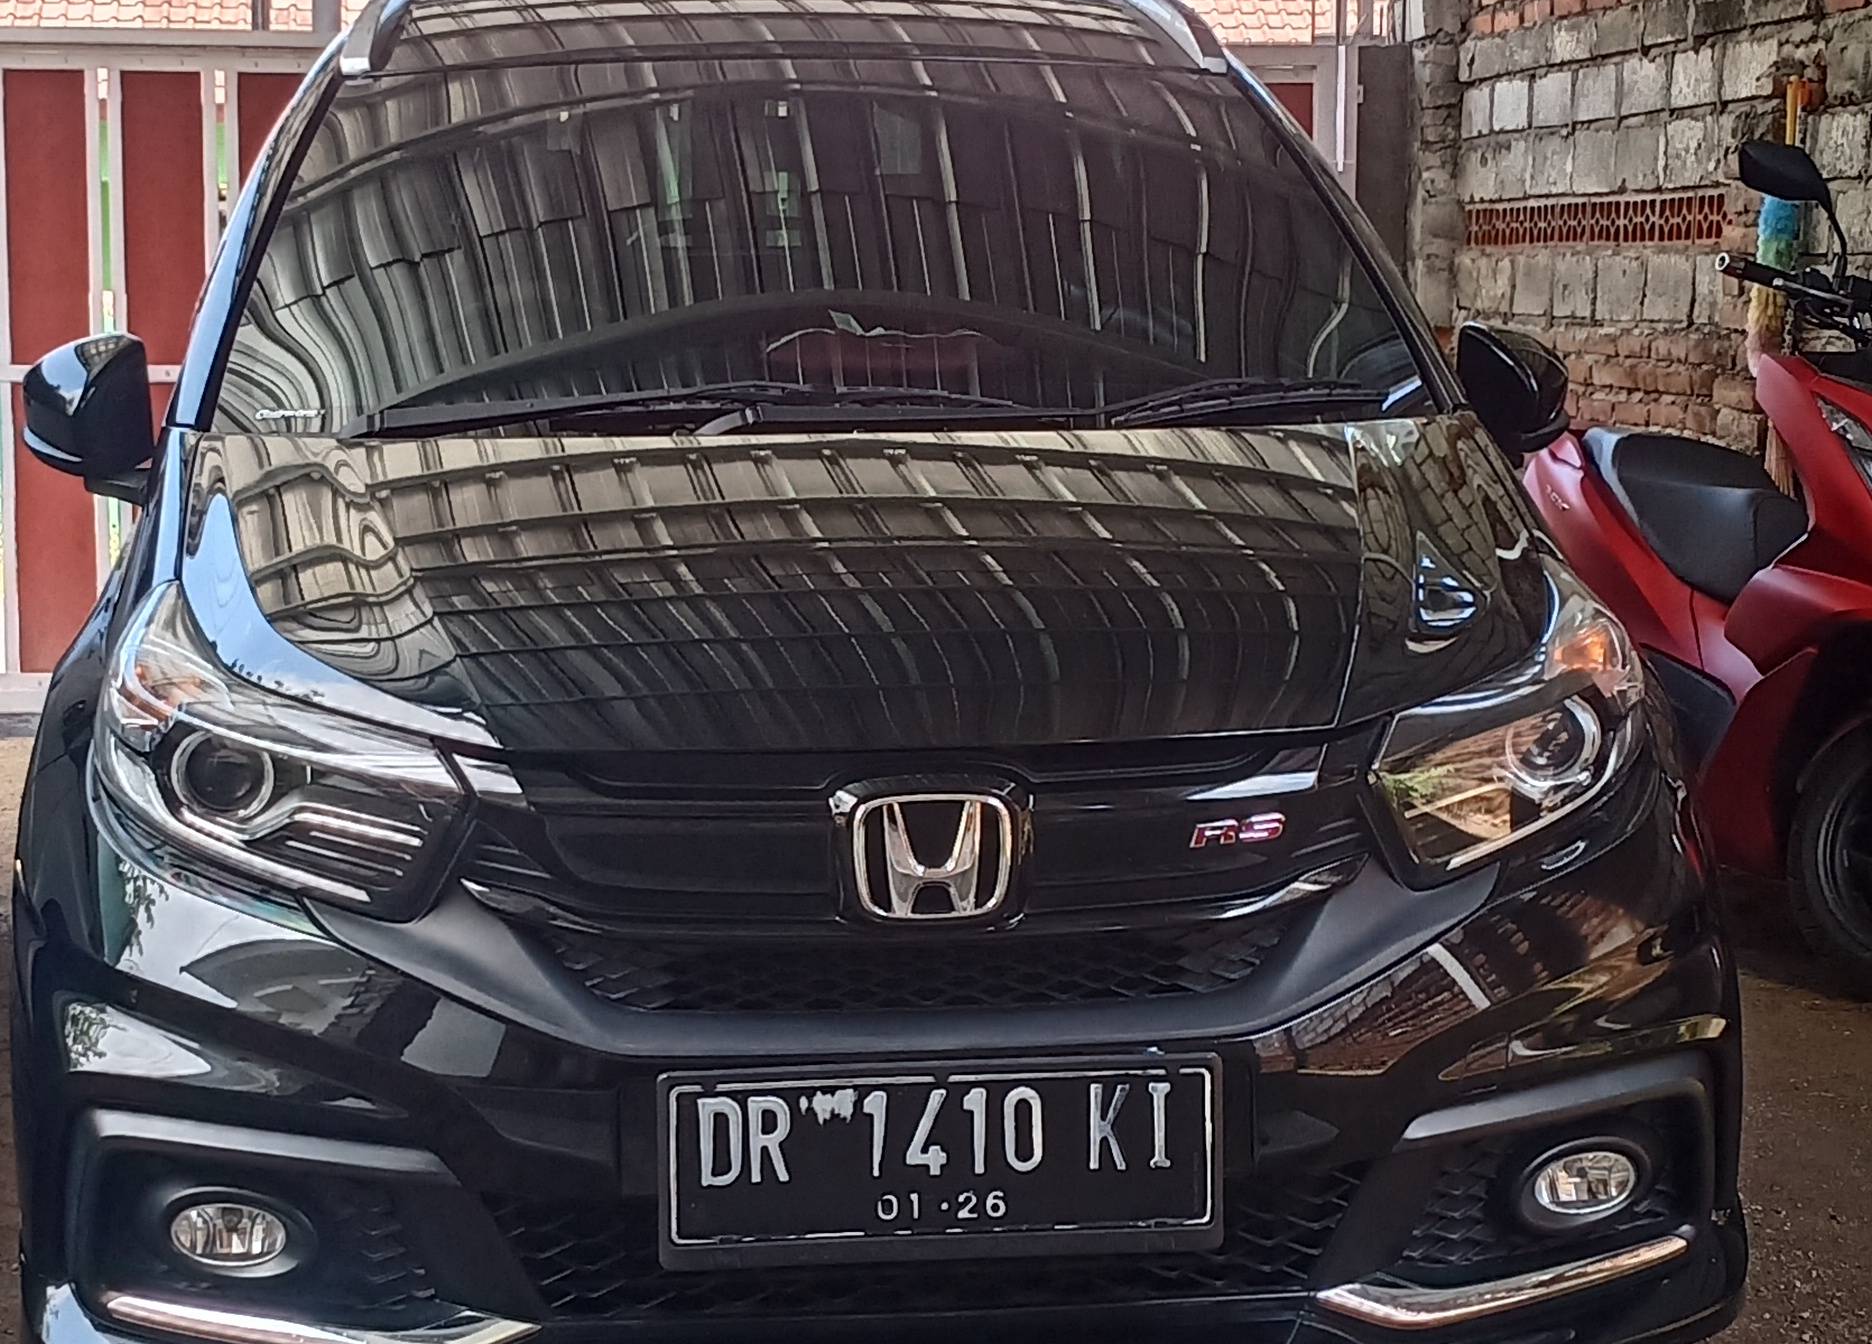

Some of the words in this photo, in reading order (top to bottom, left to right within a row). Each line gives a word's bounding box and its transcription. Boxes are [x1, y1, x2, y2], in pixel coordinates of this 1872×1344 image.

[1188, 811, 1287, 850] RS
[698, 1094, 791, 1188] DR
[862, 1085, 1044, 1178] 1410
[1088, 1081, 1172, 1171] KI
